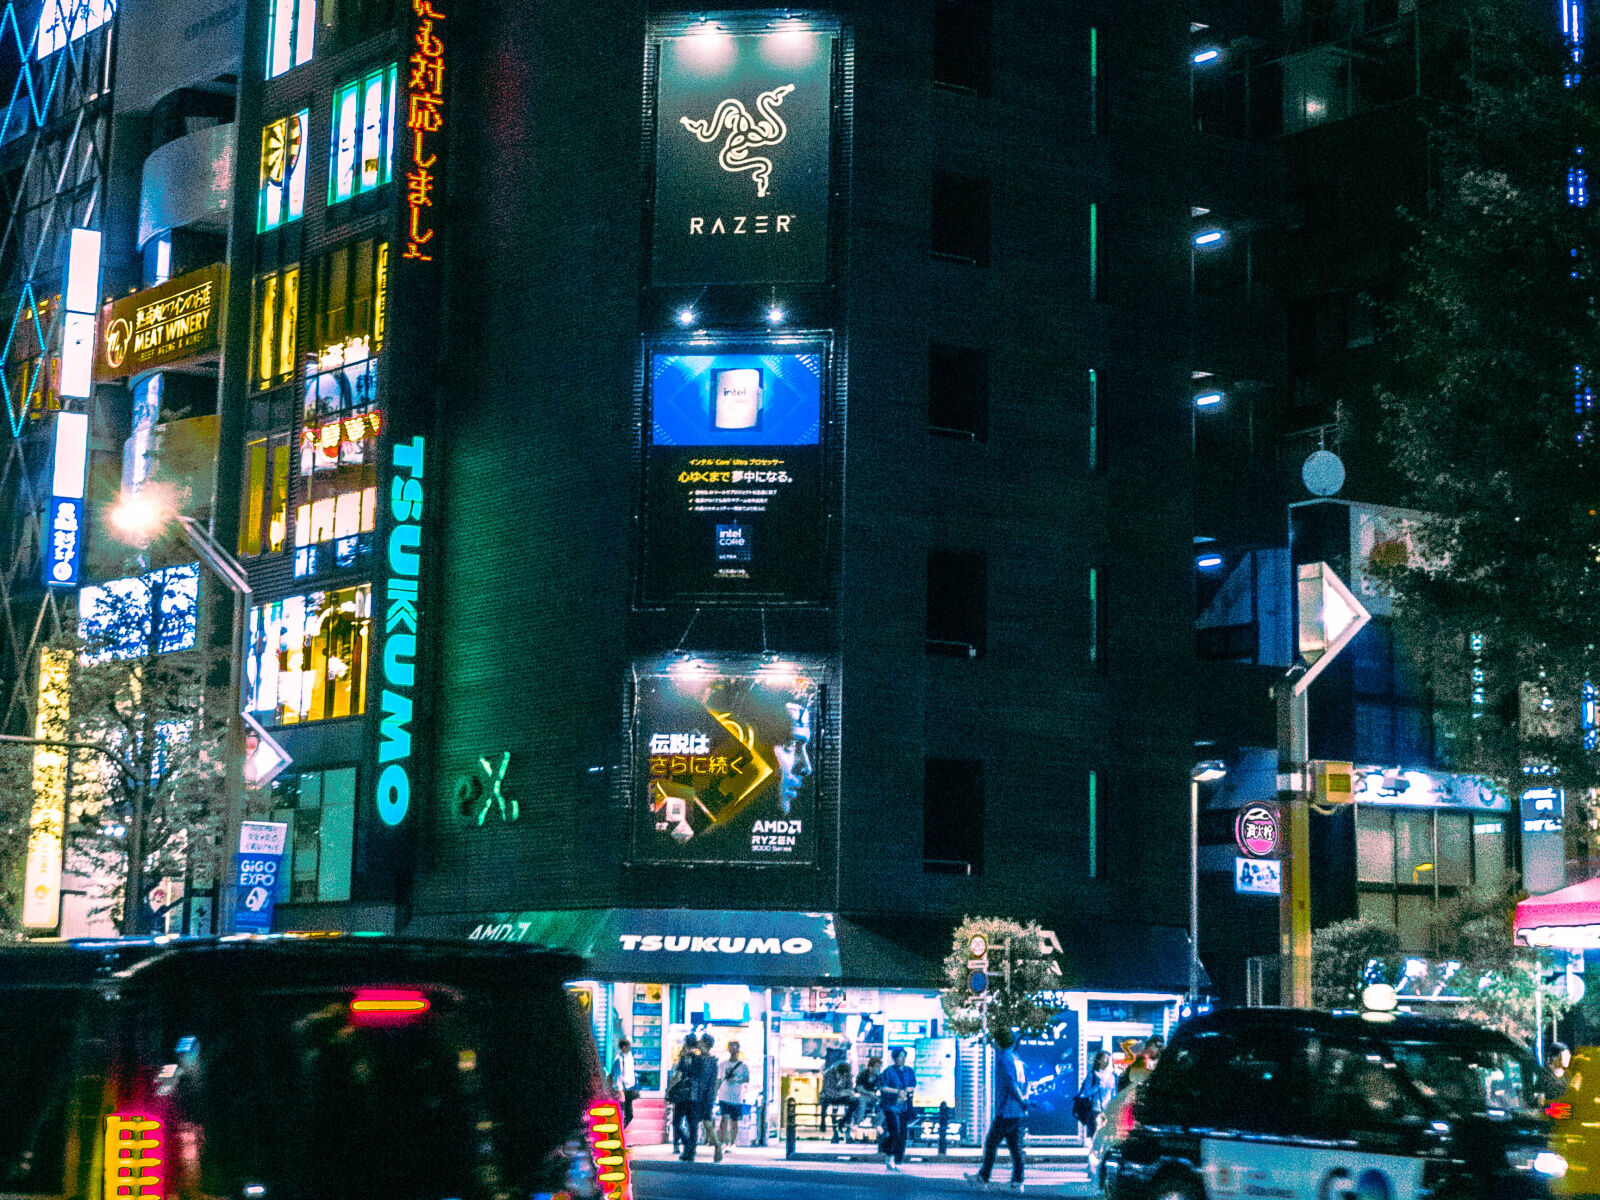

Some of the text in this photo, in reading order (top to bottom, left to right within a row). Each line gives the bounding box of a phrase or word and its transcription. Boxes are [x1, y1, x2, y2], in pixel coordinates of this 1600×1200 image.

[689, 215, 791, 235] RAZER
[134, 326, 164, 353] MEAT
[166, 309, 211, 342] WINERY
[723, 387, 746, 397] intel
[719, 528, 742, 538] intel
[377, 436, 425, 826] TSUKUMO
[649, 733, 710, 755] 伝説は
[650, 755, 743, 775] さらに続く
[752, 820, 788, 834] AMD
[1246, 823, 1274, 841] 消火栓
[752, 835, 796, 846] RYZEN
[240, 873, 275, 886] EXPO
[468, 924, 511, 942] AMD
[619, 934, 813, 955] TSUKUMO
